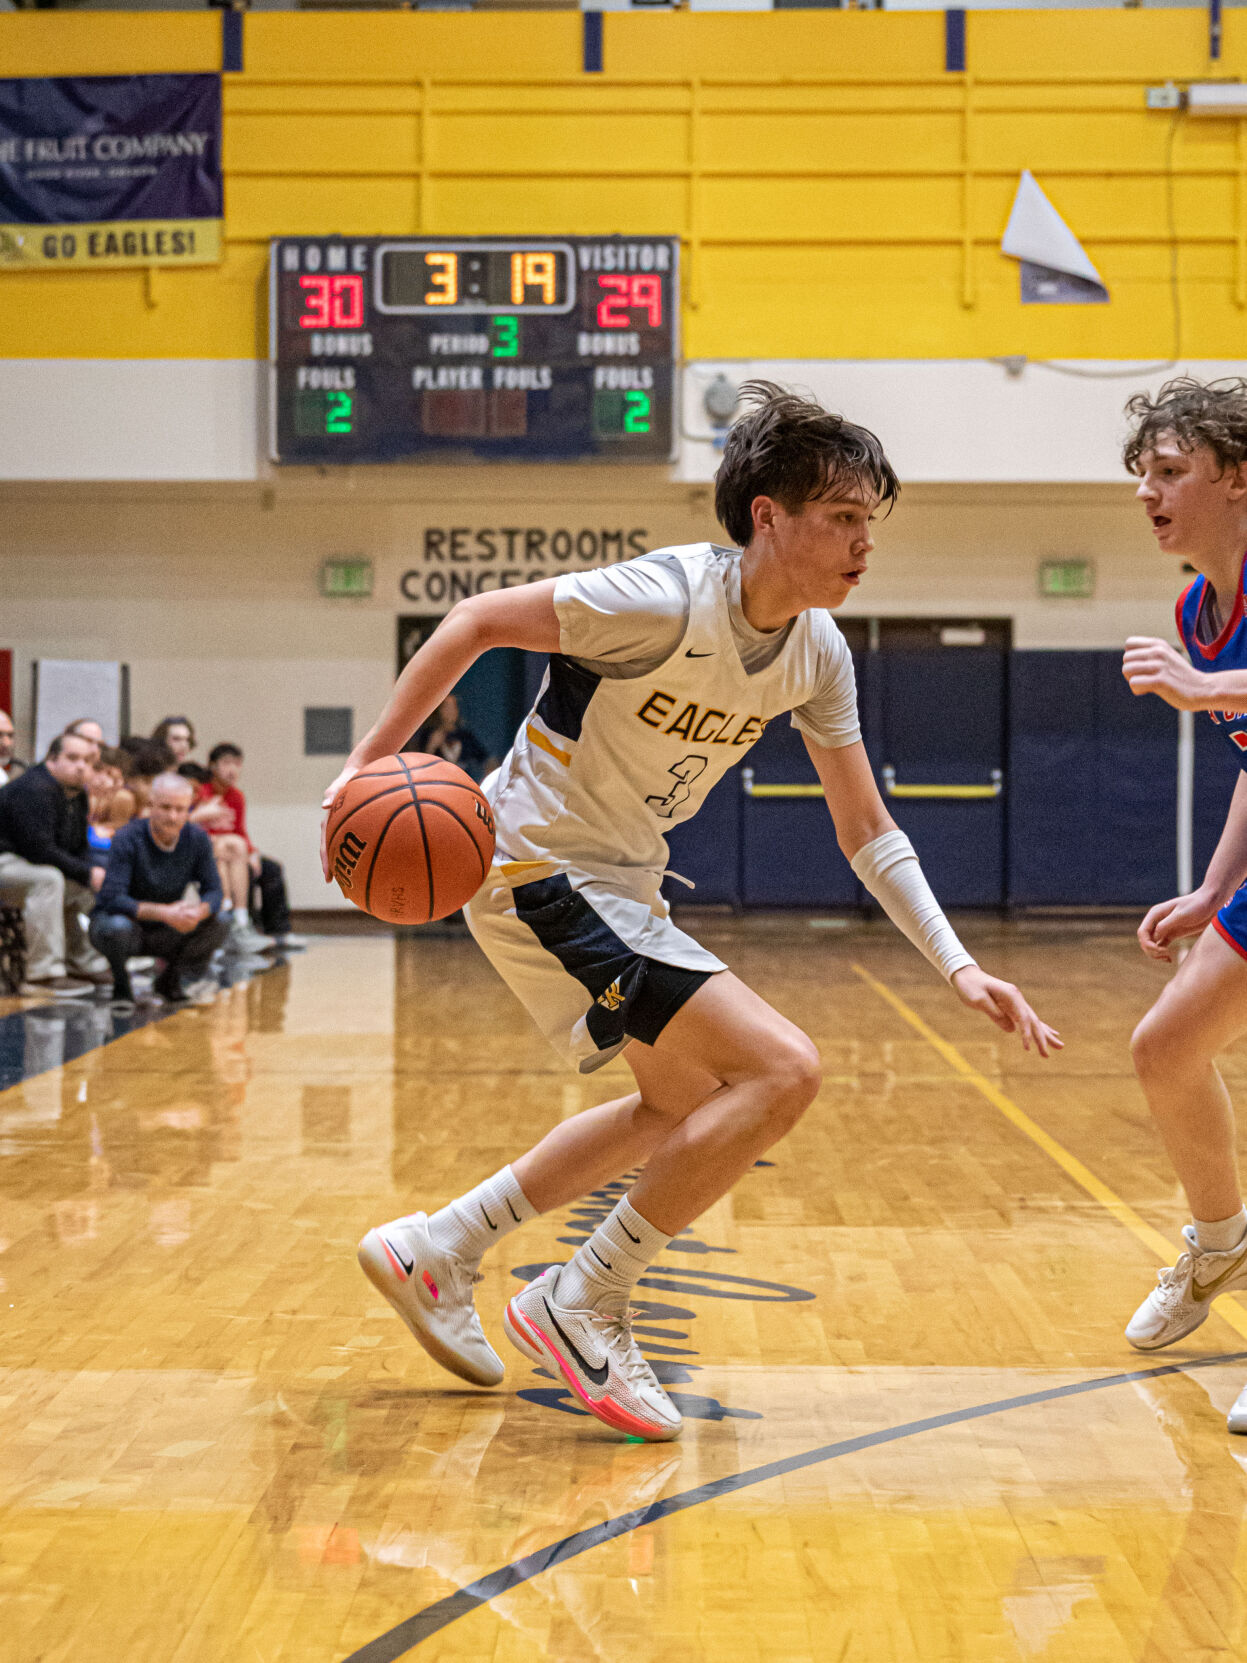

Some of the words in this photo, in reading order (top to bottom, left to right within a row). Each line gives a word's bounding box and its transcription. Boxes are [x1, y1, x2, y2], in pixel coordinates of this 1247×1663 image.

[24, 136, 87, 162] FRUIT
[92, 132, 208, 161] COMPANY
[42, 234, 77, 259] GO
[88, 231, 196, 258] EAGLES!
[284, 245, 367, 271] HOME
[579, 244, 670, 271] VISITOR
[299, 274, 364, 329] 30
[597, 274, 662, 328] 29
[311, 332, 372, 356] BONUS
[429, 334, 490, 355] PERIOD
[492, 315, 519, 358] 3
[577, 332, 640, 356] BONUS
[297, 366, 355, 390] FOULS
[412, 366, 483, 390] PLAYER
[494, 366, 552, 390] FOULS
[595, 366, 653, 390] FOULS
[326, 391, 352, 433] 2
[624, 391, 651, 433] 2
[424, 527, 648, 561] RESTROOMS
[645, 754, 709, 819] 3
